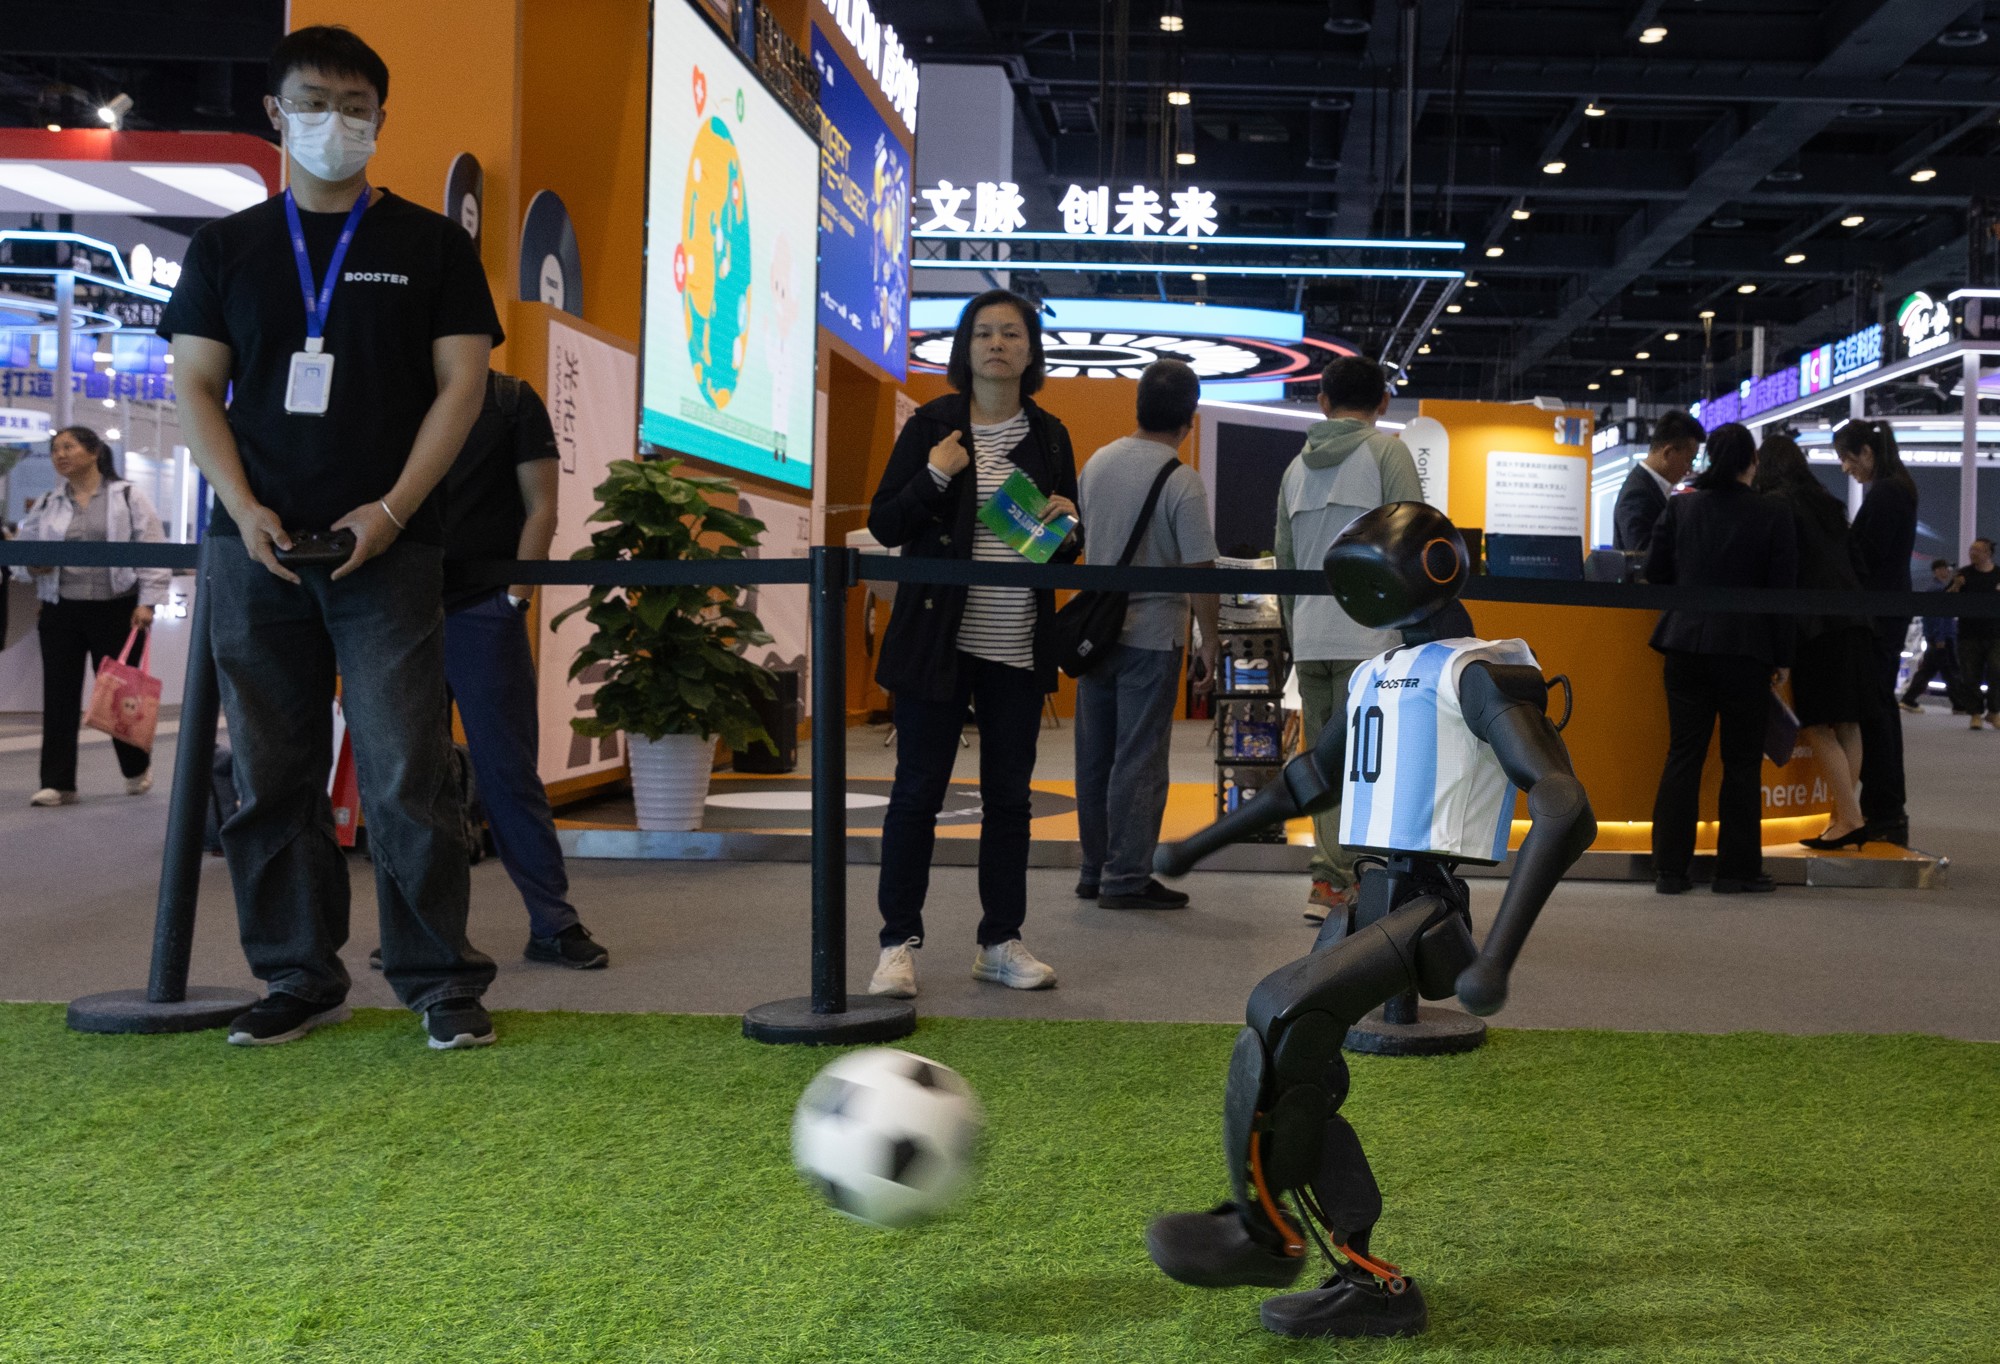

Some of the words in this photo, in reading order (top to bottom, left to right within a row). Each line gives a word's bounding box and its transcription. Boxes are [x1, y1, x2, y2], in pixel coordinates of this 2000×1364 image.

[1058, 183, 1219, 238] 创未来
[344, 271, 409, 285] BOOSTER
[1374, 678, 1420, 690] BOOSTER
[1349, 705, 1384, 783] 10
